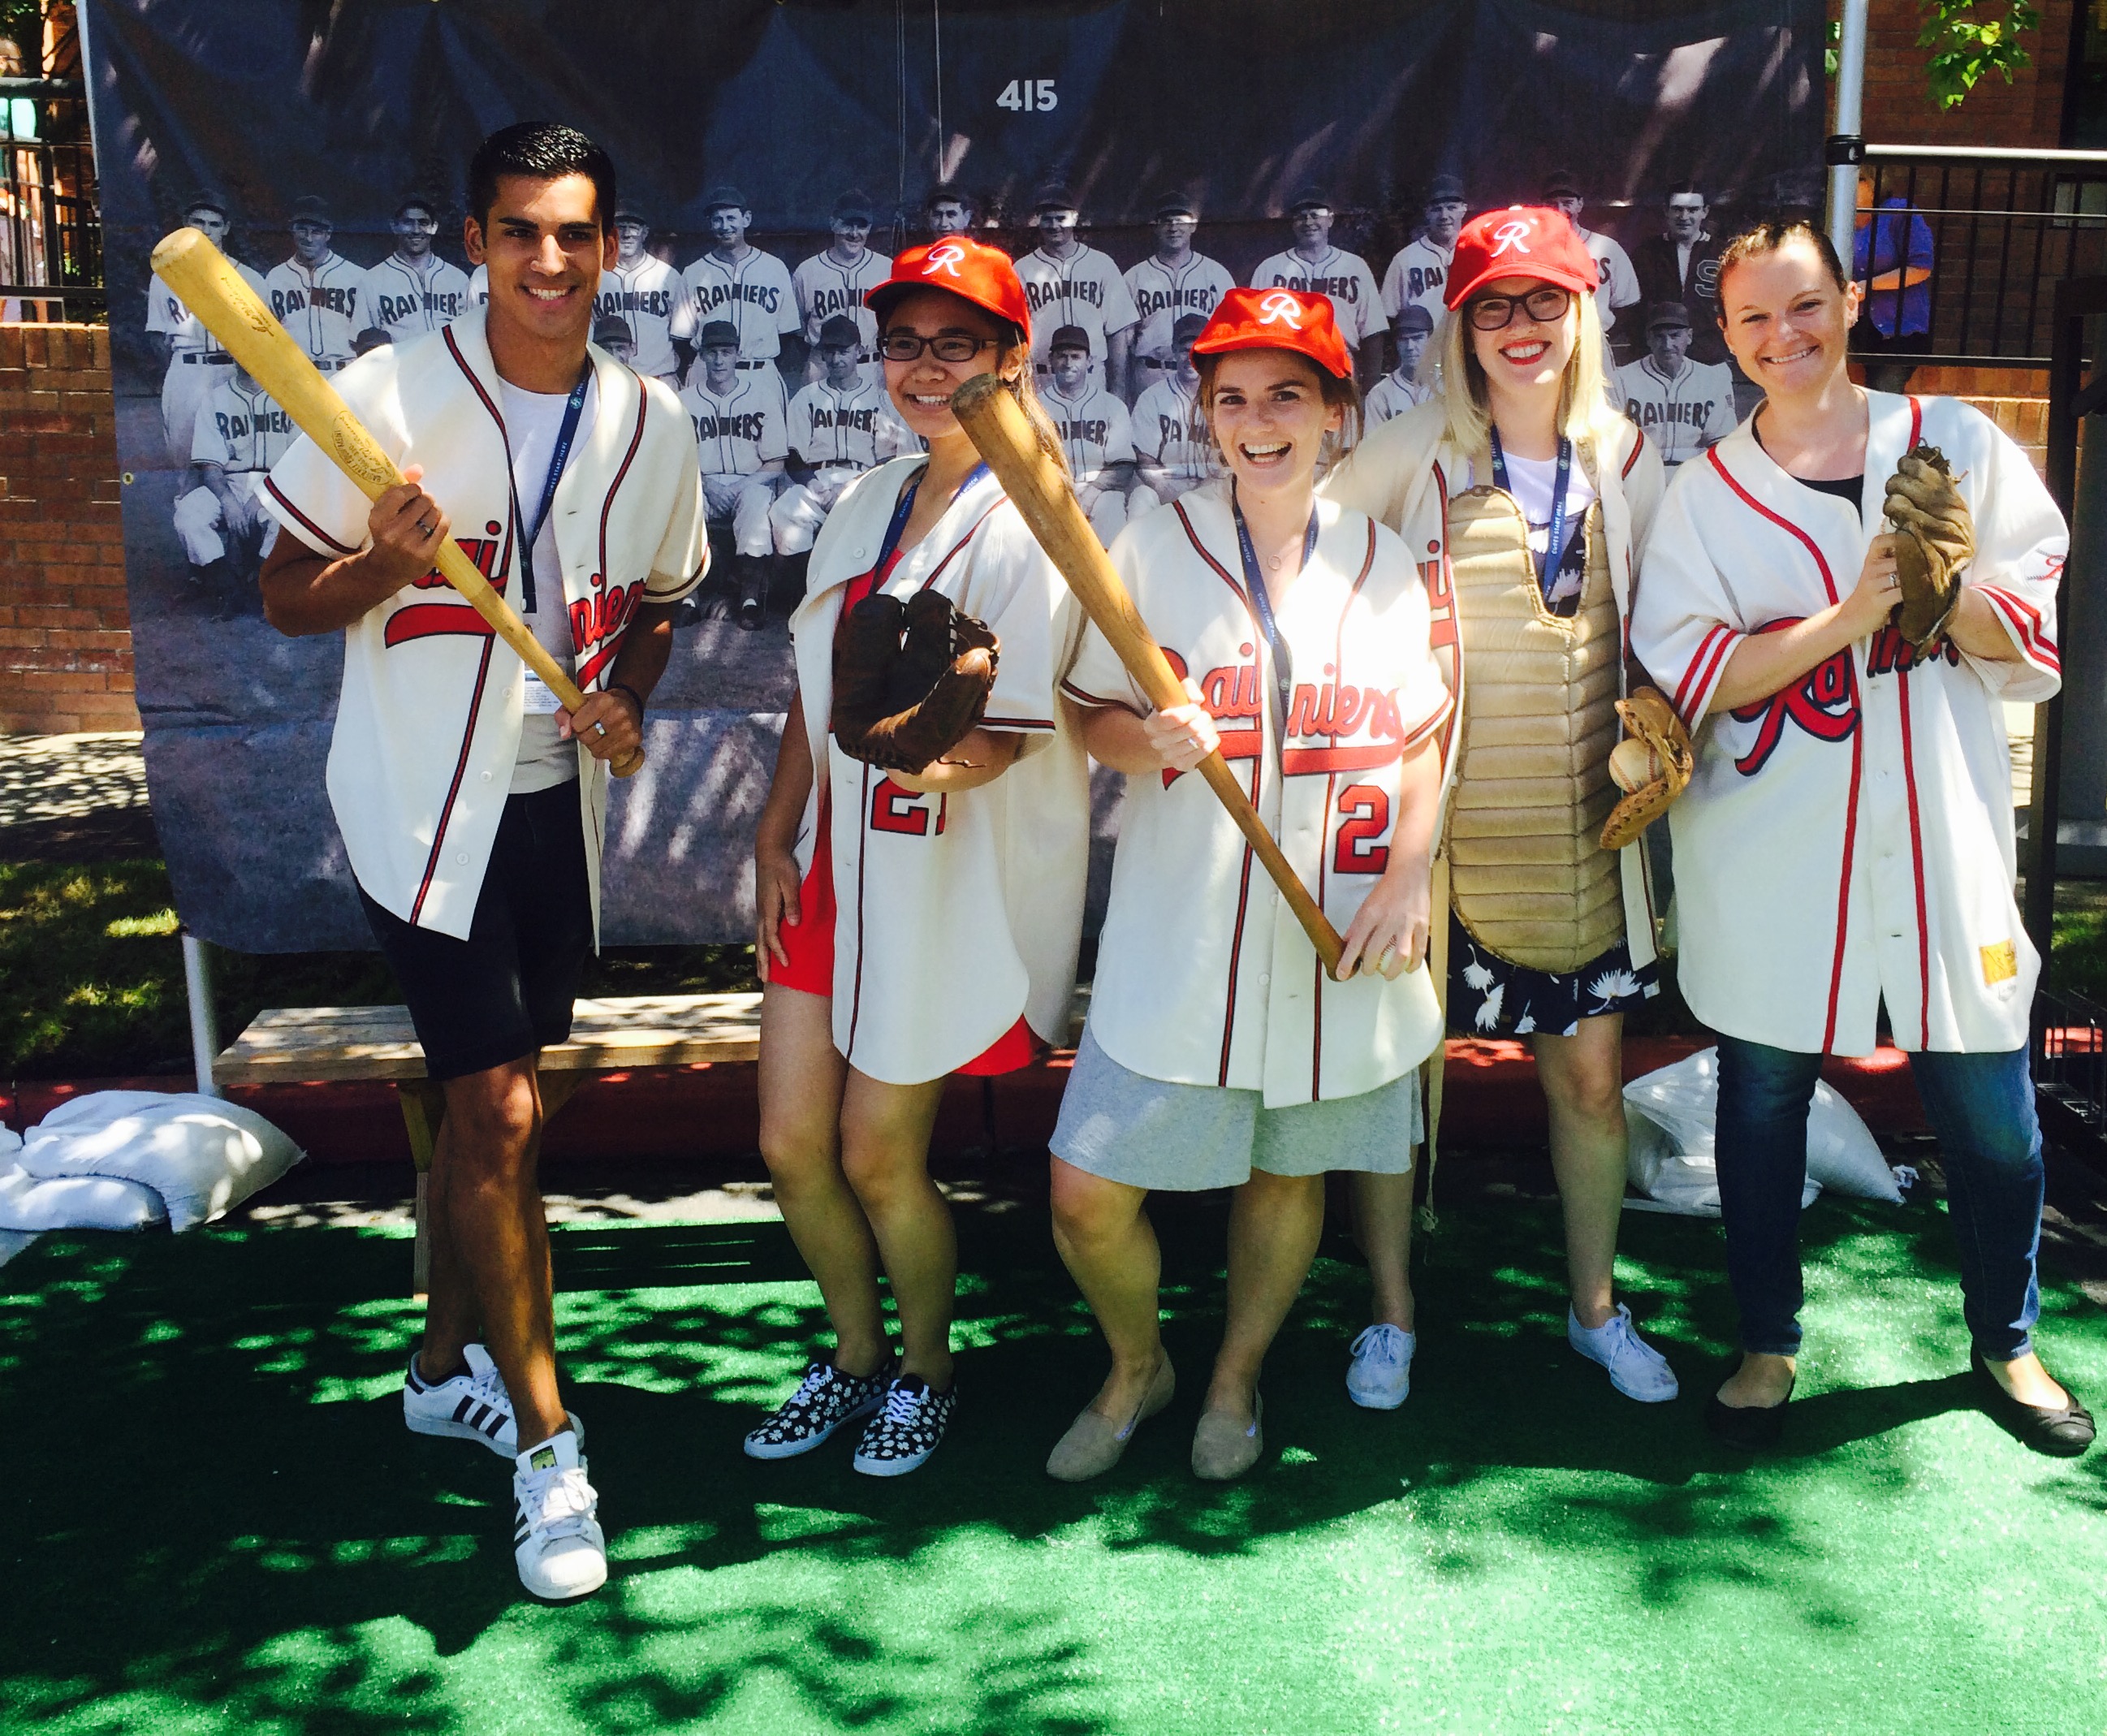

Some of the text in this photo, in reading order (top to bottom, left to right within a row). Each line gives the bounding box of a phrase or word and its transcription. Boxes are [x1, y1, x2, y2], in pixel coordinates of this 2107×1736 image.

[995, 79, 1058, 112] 415
[1490, 222, 1531, 258] R
[922, 244, 966, 278] R
[697, 283, 780, 315] RAINIERS
[814, 287, 870, 320] RAINI
[1259, 292, 1302, 330] R
[1553, 516, 1561, 535] START
